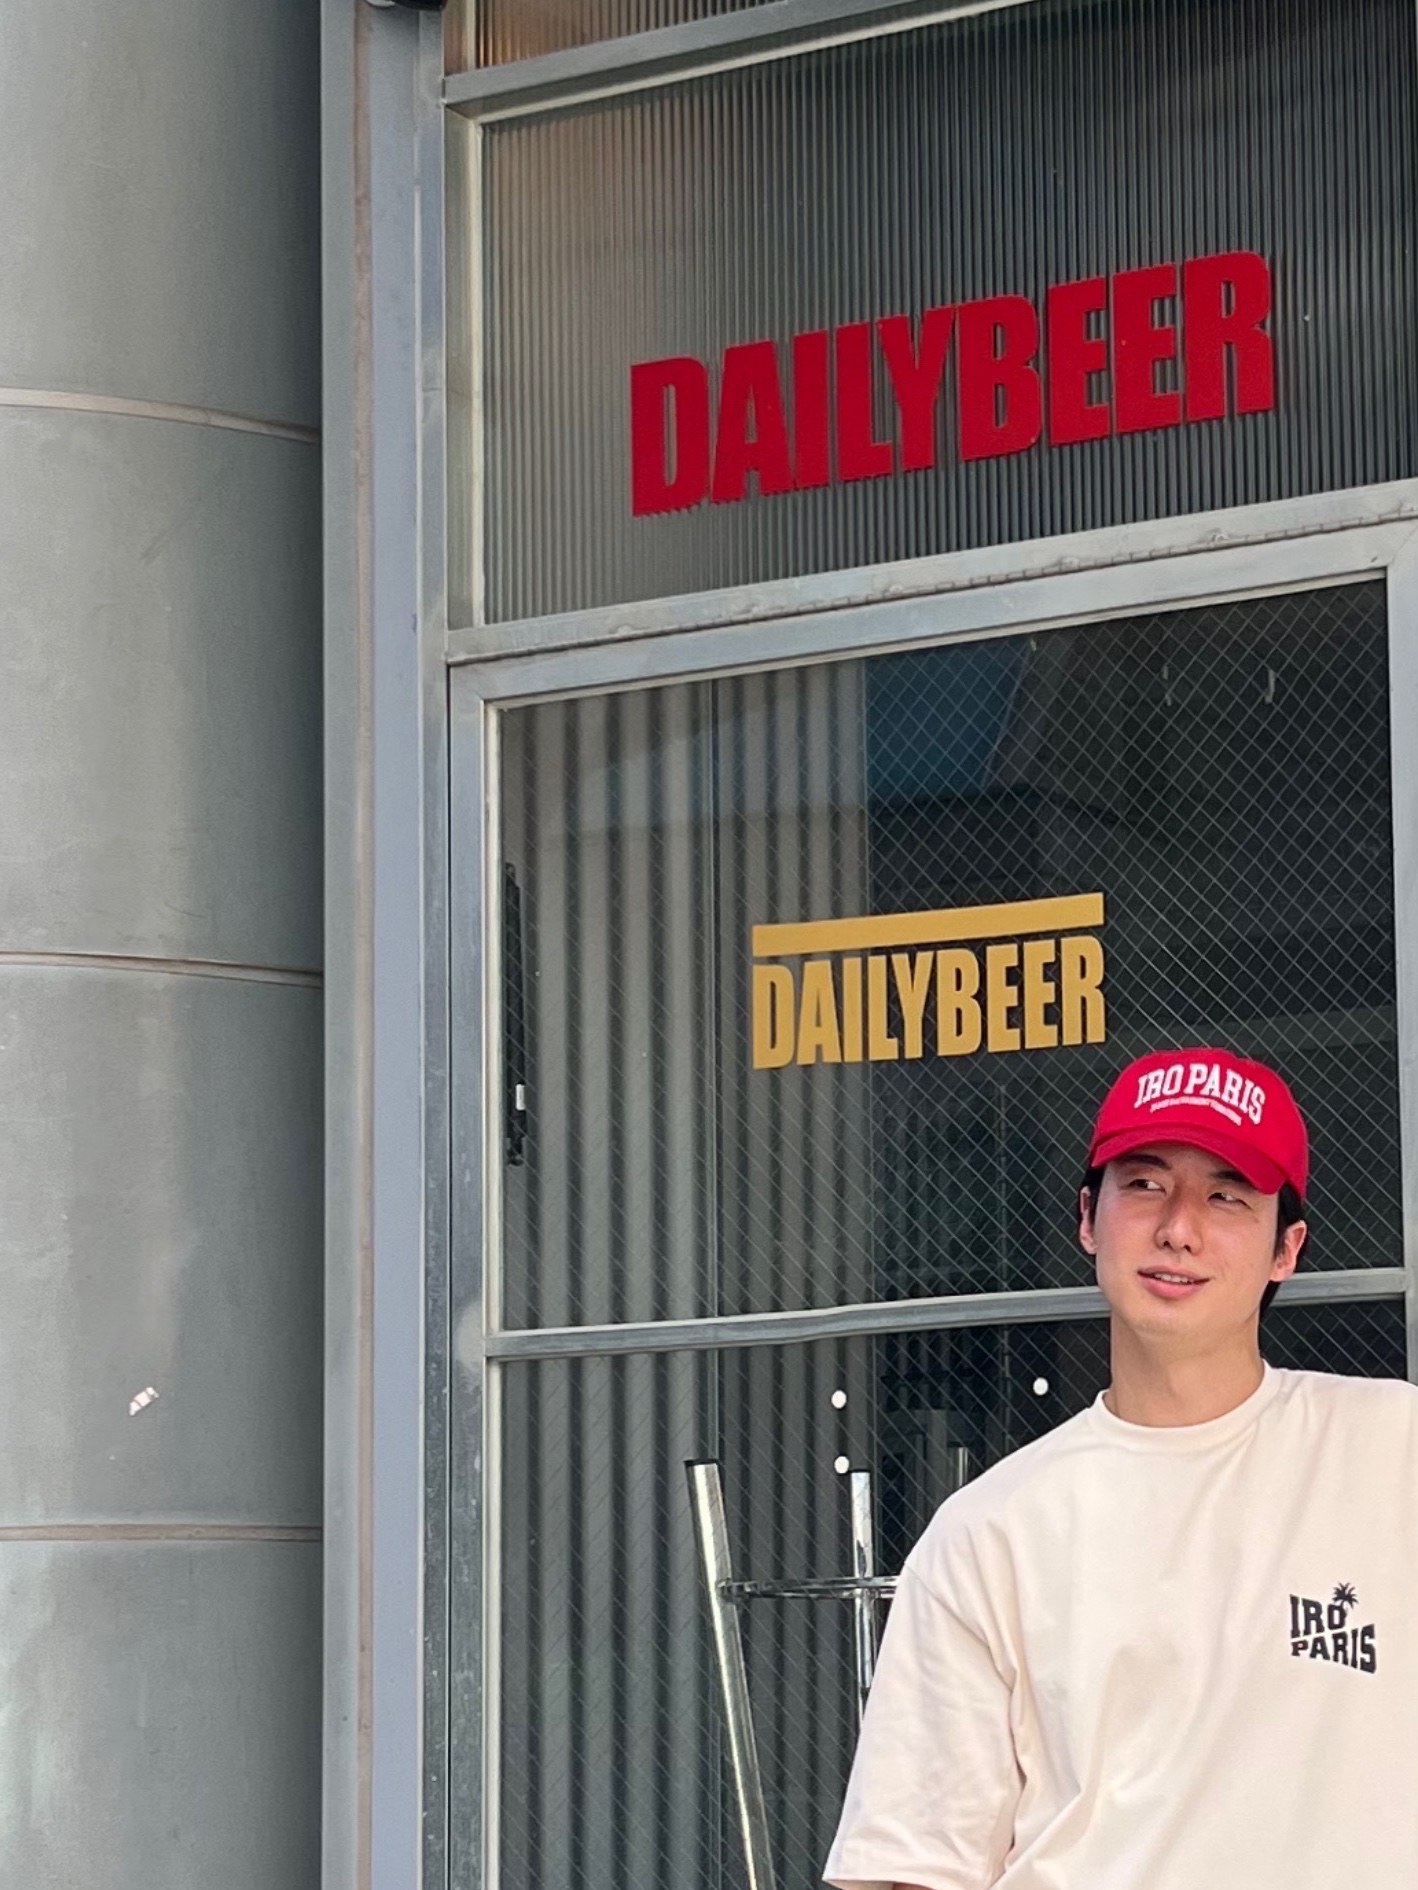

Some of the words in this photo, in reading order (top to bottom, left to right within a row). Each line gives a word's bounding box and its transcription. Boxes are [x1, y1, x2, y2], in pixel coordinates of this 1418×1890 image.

[630, 250, 1275, 517] DAILYBEER
[752, 935, 1106, 1070] DAILYBEER
[1132, 1063, 1185, 1109] IRO
[1183, 1063, 1266, 1125] PARIS
[1289, 1593, 1348, 1639] IRO
[1290, 1623, 1377, 1675] PARIS
